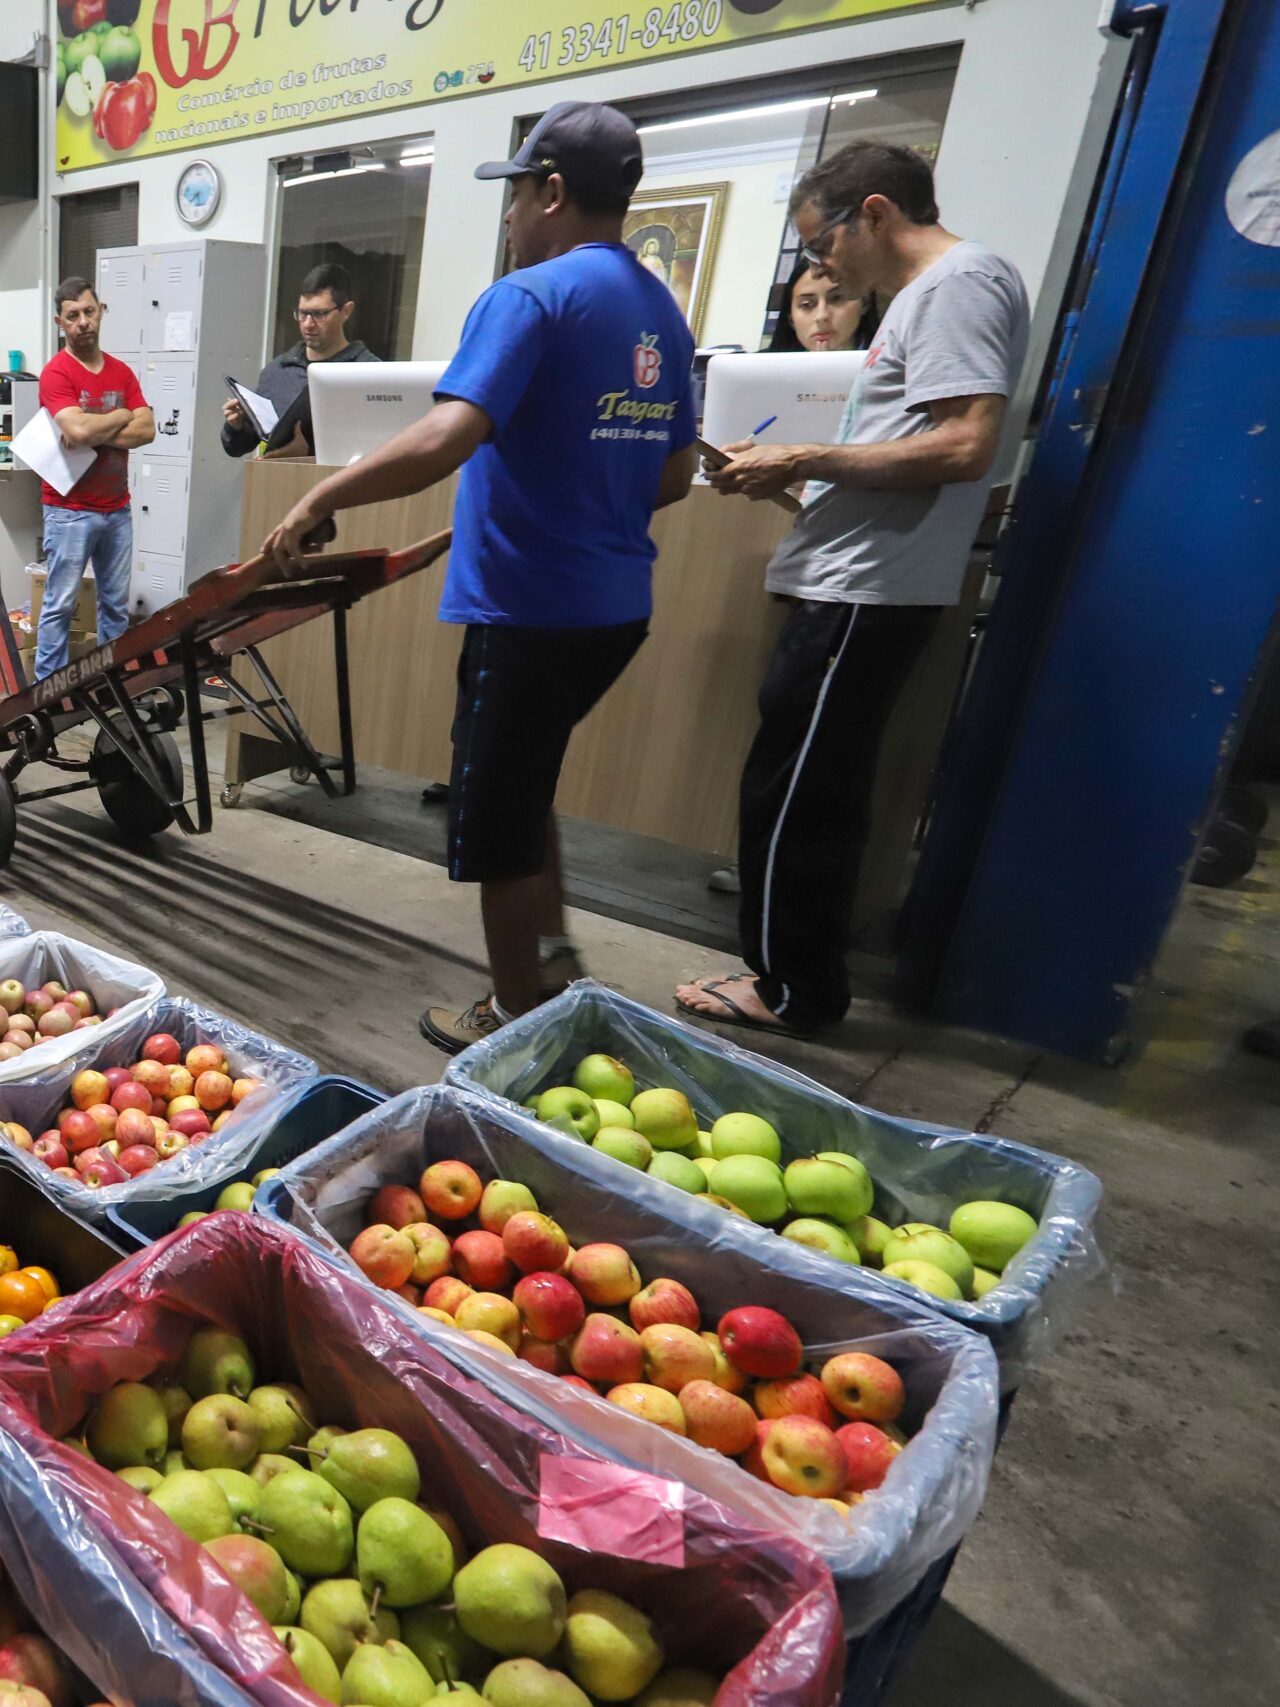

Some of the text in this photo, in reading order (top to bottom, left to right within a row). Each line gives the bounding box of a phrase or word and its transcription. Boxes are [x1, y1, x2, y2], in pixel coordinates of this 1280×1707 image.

[519, 0, 724, 72] 41 3341-8480
[155, 78, 413, 144] nacionais e importados
[177, 53, 387, 112] Comércio de frutas
[366, 394, 403, 402] SAMSUNG
[796, 393, 849, 403] SAMSUN
